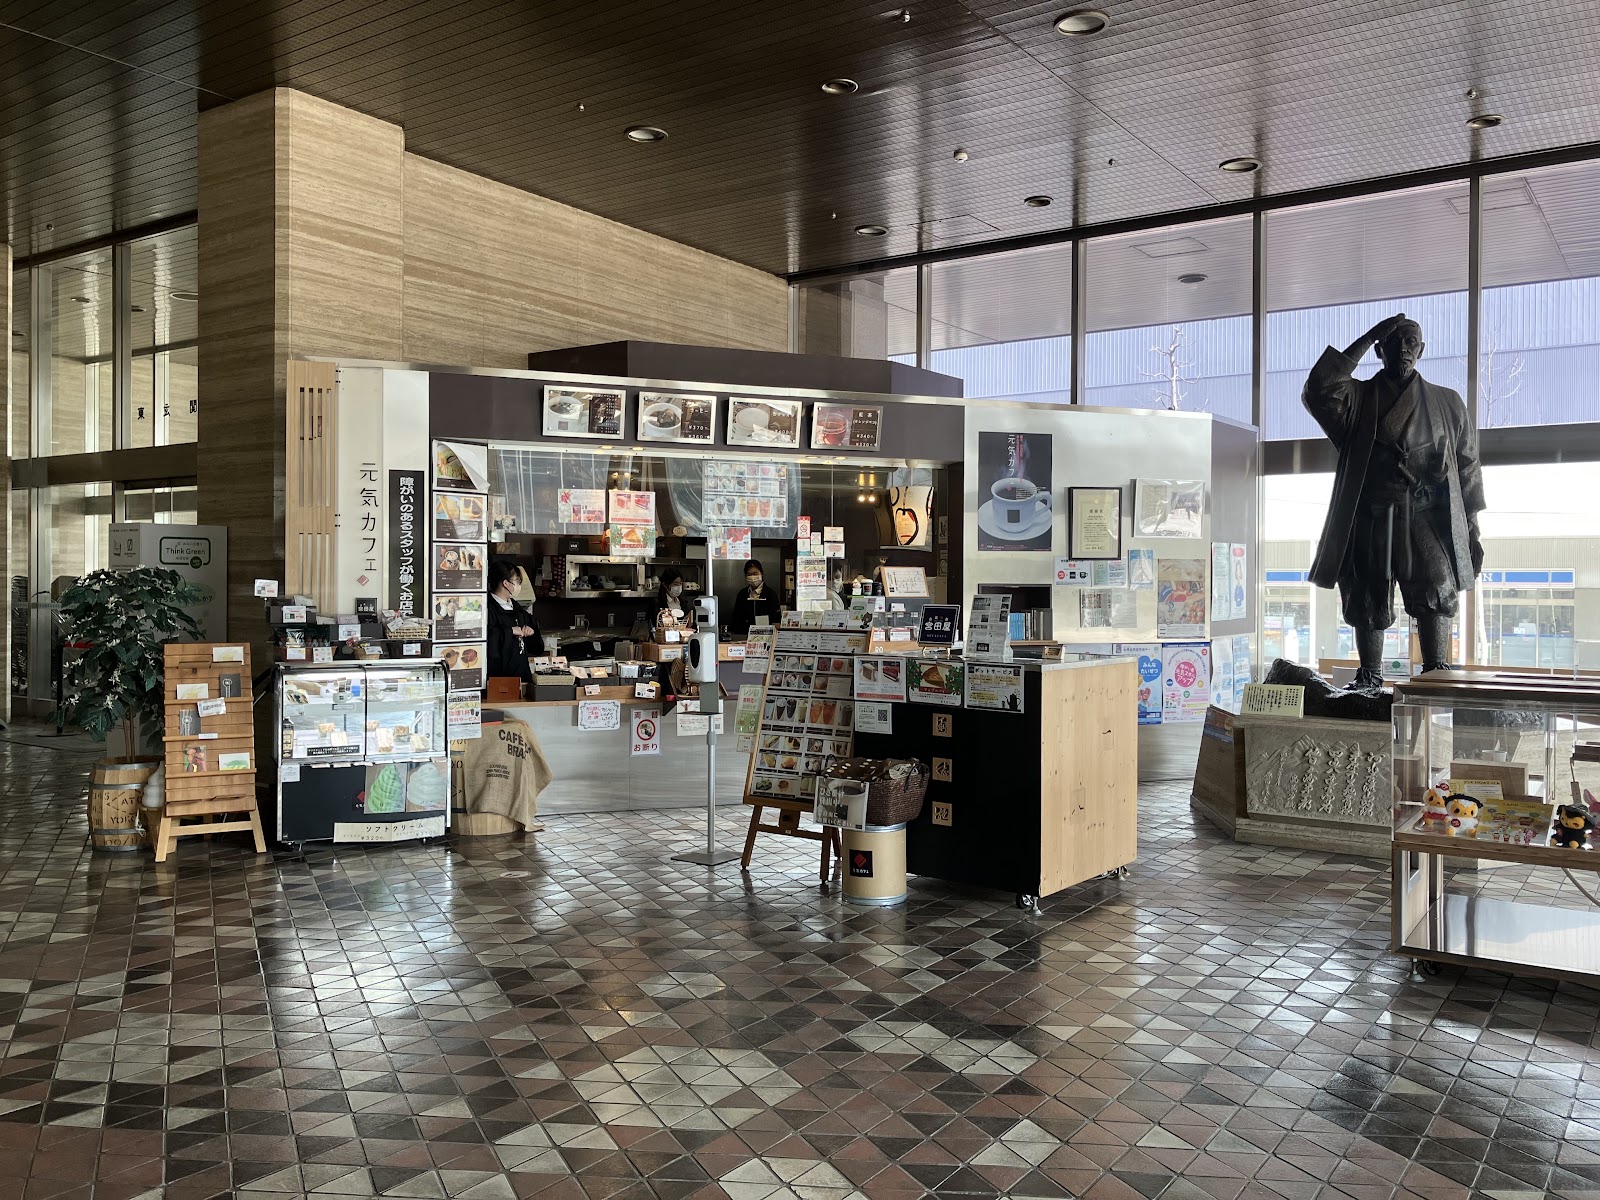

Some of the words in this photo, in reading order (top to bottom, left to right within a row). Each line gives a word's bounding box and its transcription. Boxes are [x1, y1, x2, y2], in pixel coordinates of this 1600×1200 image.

[359, 462, 379, 571] 元気カフェ
[165, 547, 185, 555] Think
[498, 729, 524, 747] CAFÉ
[633, 743, 658, 752] お断り
[366, 823, 424, 833] ソフトクリーム
